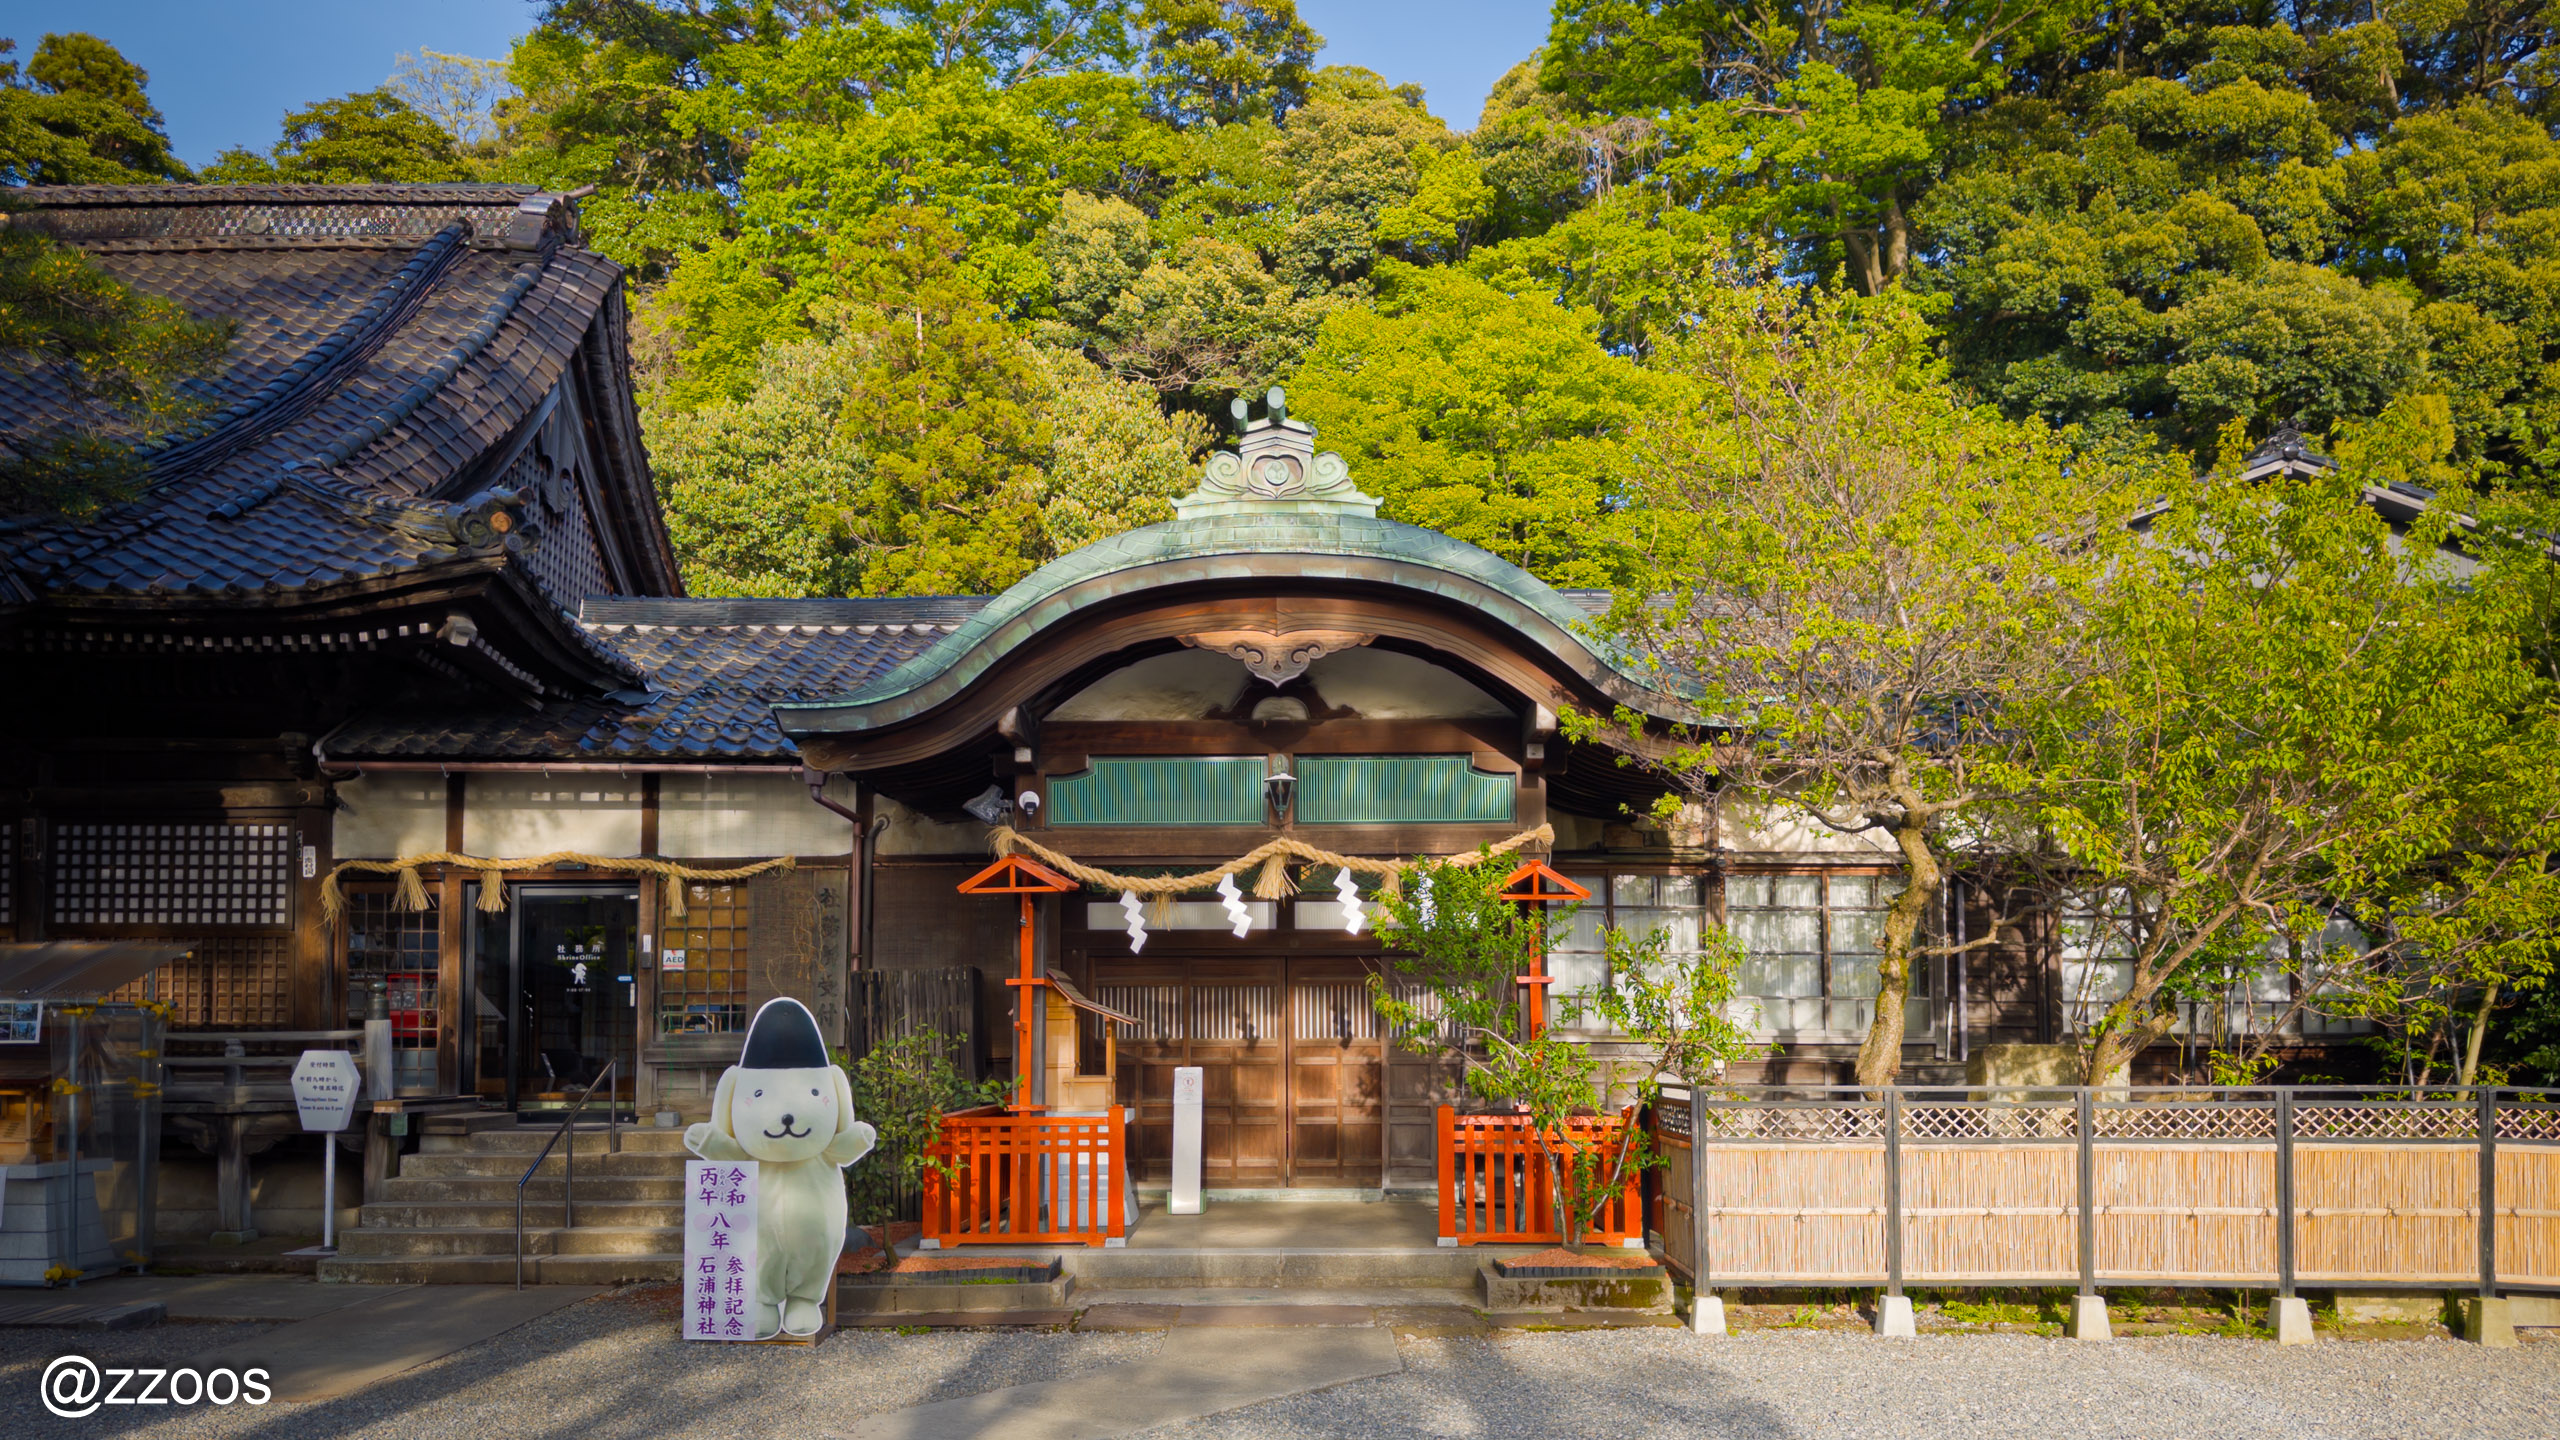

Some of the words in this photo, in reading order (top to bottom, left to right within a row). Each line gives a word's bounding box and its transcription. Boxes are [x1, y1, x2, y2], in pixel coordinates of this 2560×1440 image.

[556, 944, 602, 954] 社務所
[699, 1167, 719, 1207] 丙午
[726, 1167, 747, 1207] 令和
[710, 1212, 731, 1250] 八年
[696, 1256, 717, 1336] 石浦神社
[724, 1256, 745, 1337] 参拝記念
